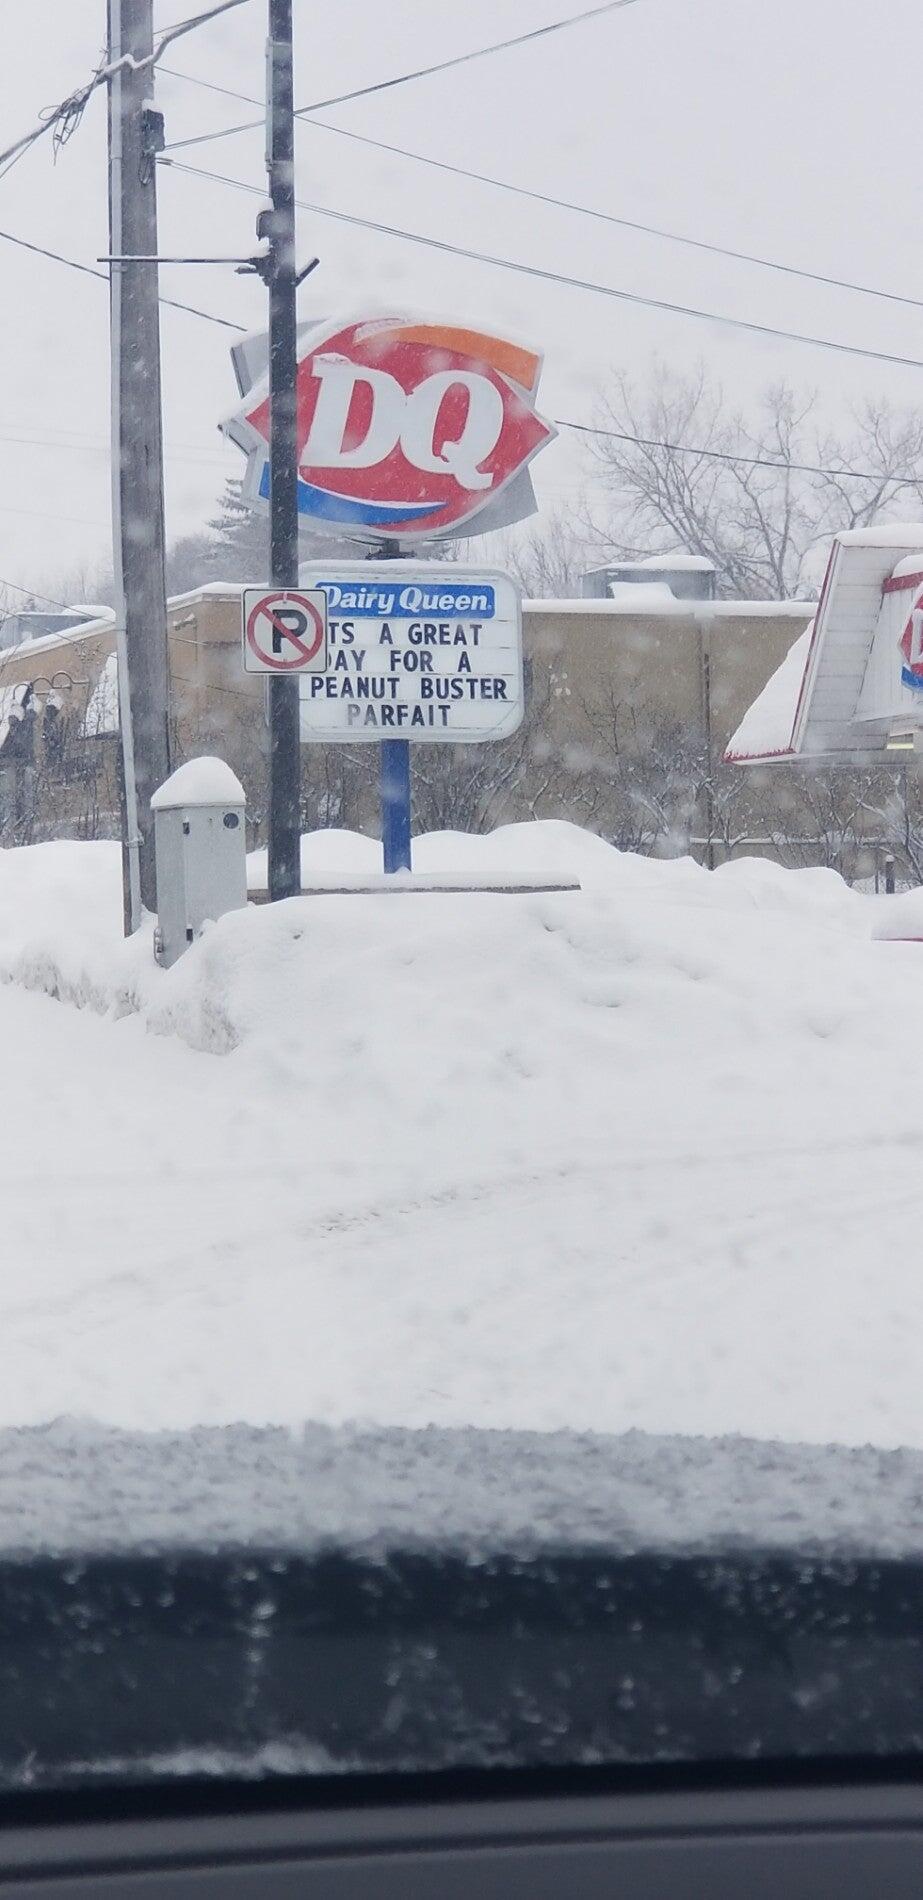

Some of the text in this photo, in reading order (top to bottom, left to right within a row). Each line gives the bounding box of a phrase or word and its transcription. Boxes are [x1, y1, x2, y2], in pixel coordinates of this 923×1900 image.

[301, 353, 504, 490] DQ
[324, 586, 488, 614] Dairy Queen
[272, 609, 308, 653] P
[328, 622, 482, 645] TS A GREAT
[390, 650, 434, 672] FOR
[457, 651, 471, 672] A
[311, 676, 507, 699] PEANUT BUSTER
[347, 704, 451, 726] PARFAIT
